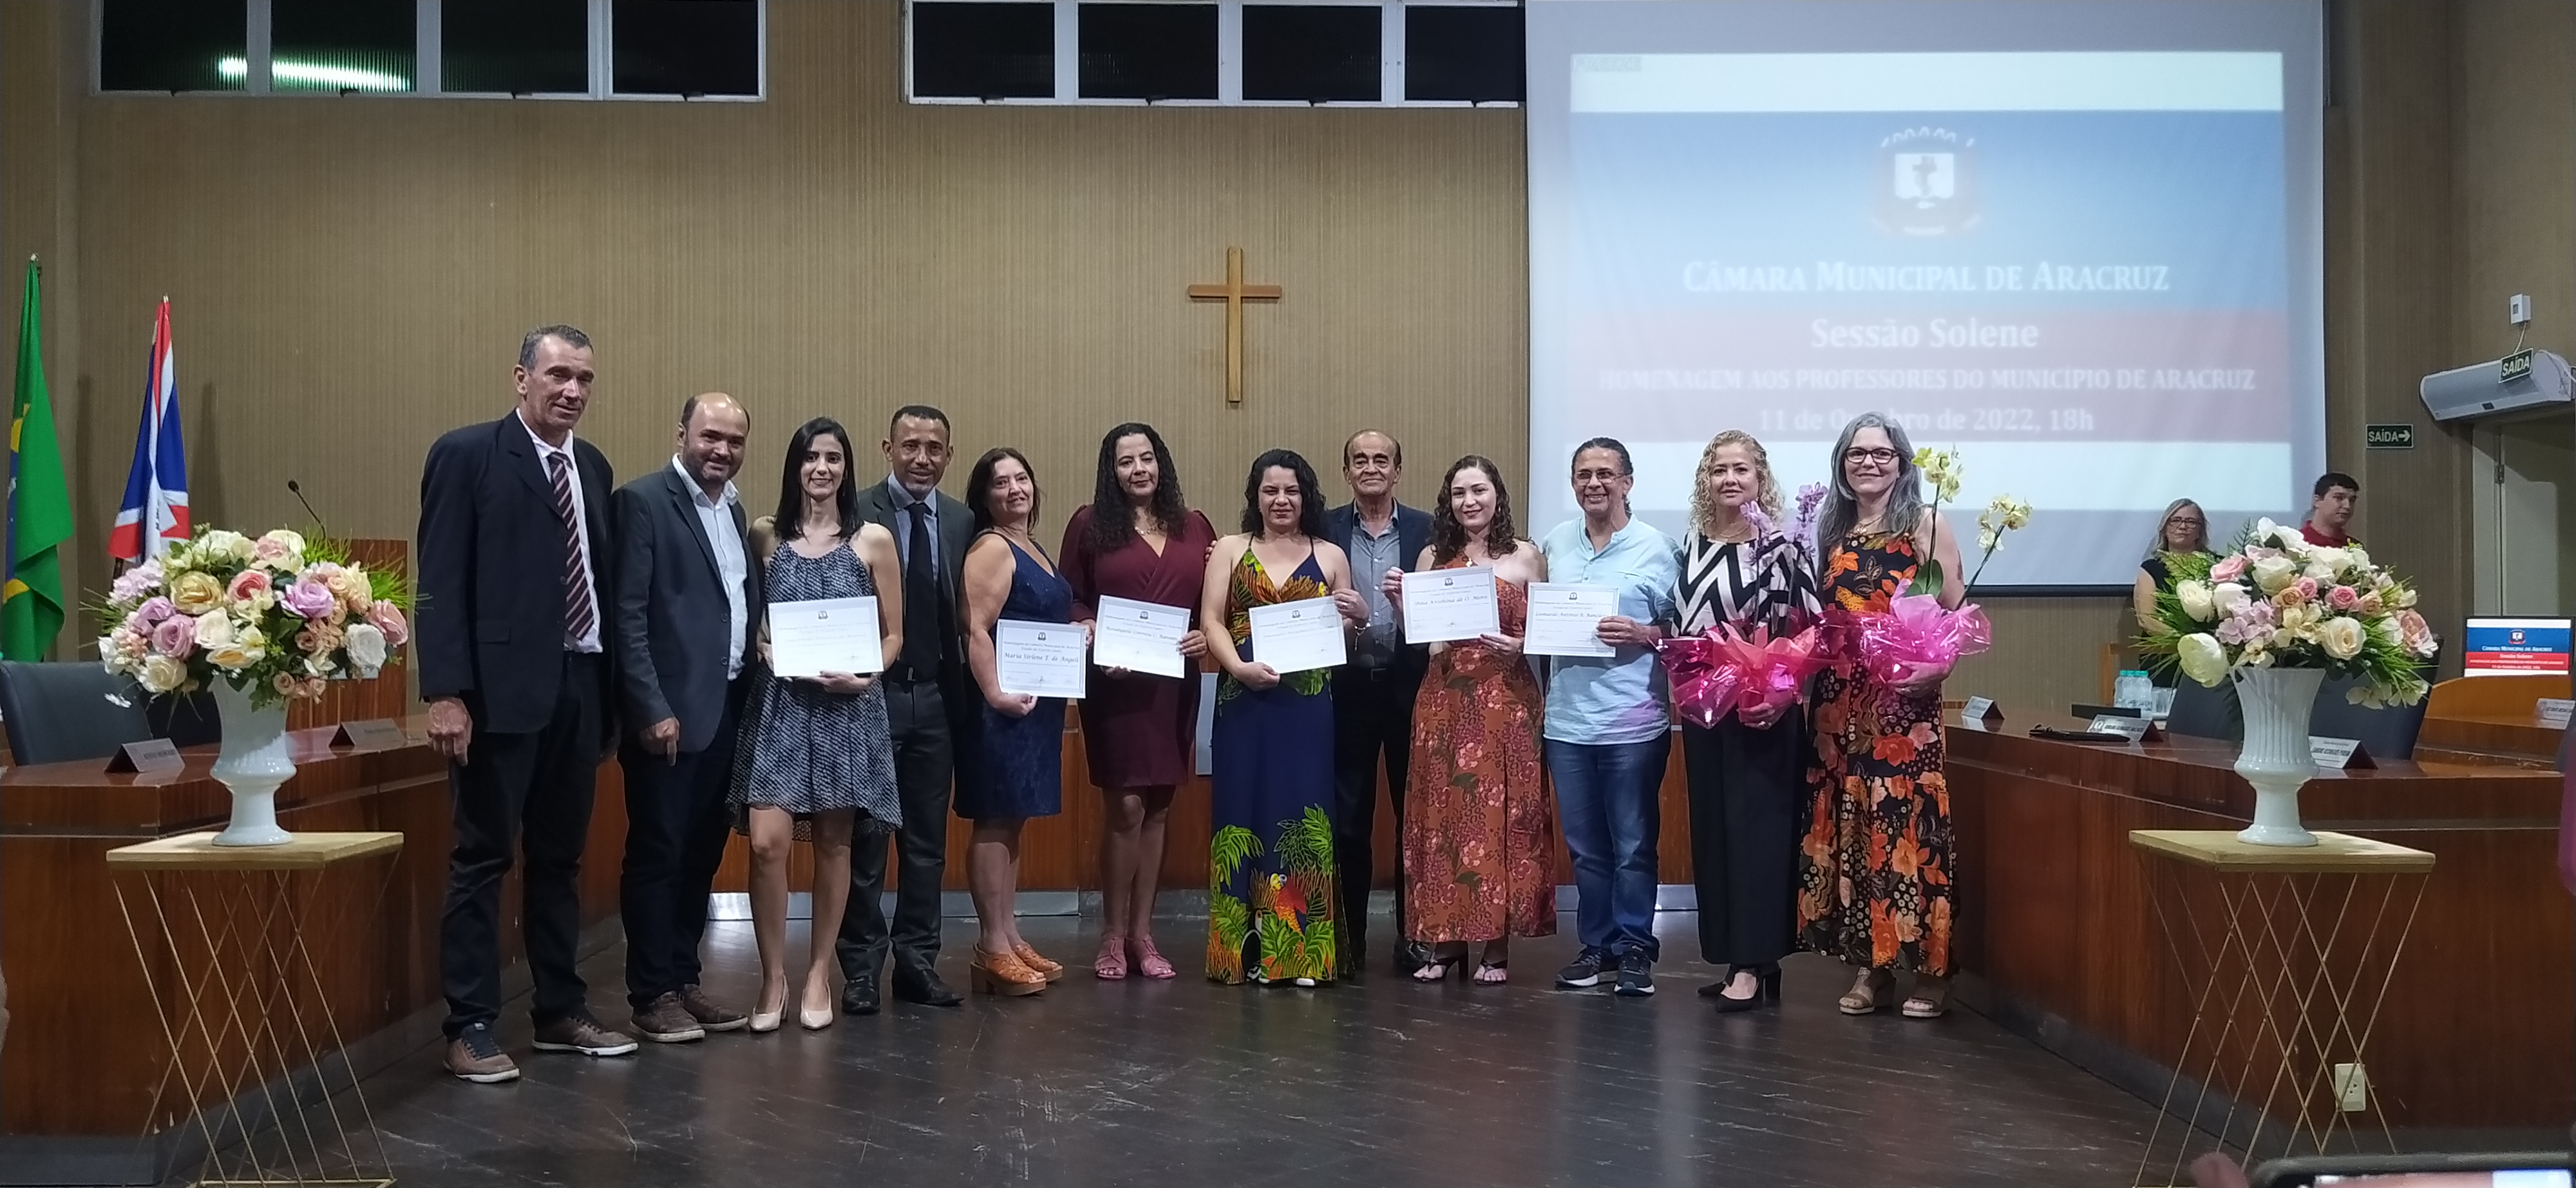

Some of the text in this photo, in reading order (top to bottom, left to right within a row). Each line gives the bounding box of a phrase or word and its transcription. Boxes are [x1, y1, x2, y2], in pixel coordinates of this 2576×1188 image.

[1683, 261, 2170, 292] CÂMARA MUNICIPAL DE ARACRUZ
[1811, 316, 2039, 349] Sessão Solene
[1598, 365, 2257, 390] HOMENAGEM AOS PROFESSORES DO MUNICÍPIO DE ARACRUZ
[2501, 356, 2531, 376] SAÍDA
[1759, 408, 1788, 430] 11
[1794, 408, 1823, 430] de
[1936, 408, 1966, 430] de
[1973, 408, 2041, 434] 2022,
[2050, 408, 2095, 431] 18h
[2368, 428, 2399, 442] SAÍDA
